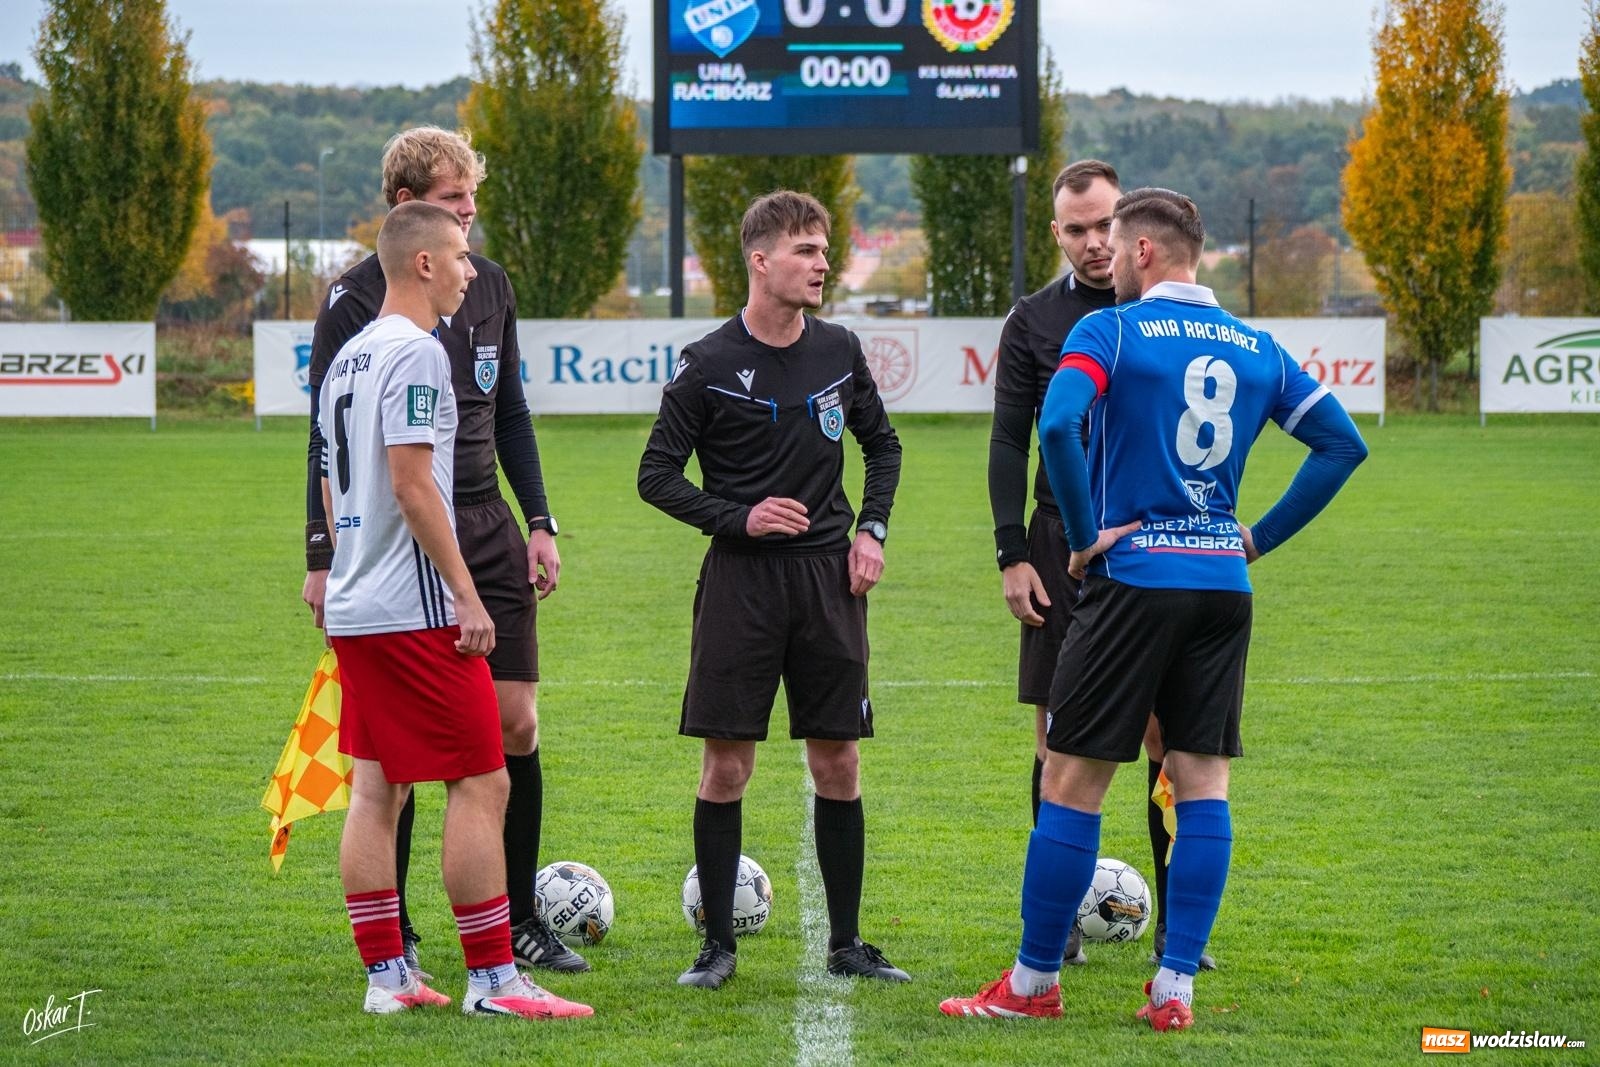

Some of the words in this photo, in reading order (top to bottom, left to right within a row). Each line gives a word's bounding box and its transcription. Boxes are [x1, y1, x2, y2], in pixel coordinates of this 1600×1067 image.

[697, 63, 747, 81] UNIA
[800, 55, 891, 88] 00:00
[672, 80, 772, 101] RACIBÓRZ
[1138, 318, 1181, 338] UNIA
[1182, 319, 1260, 354] RACIBÓRZ
[1501, 354, 1600, 385] AGR
[1176, 355, 1237, 471] 8
[552, 886, 595, 929] SELECT
[732, 910, 767, 929] SELEC
